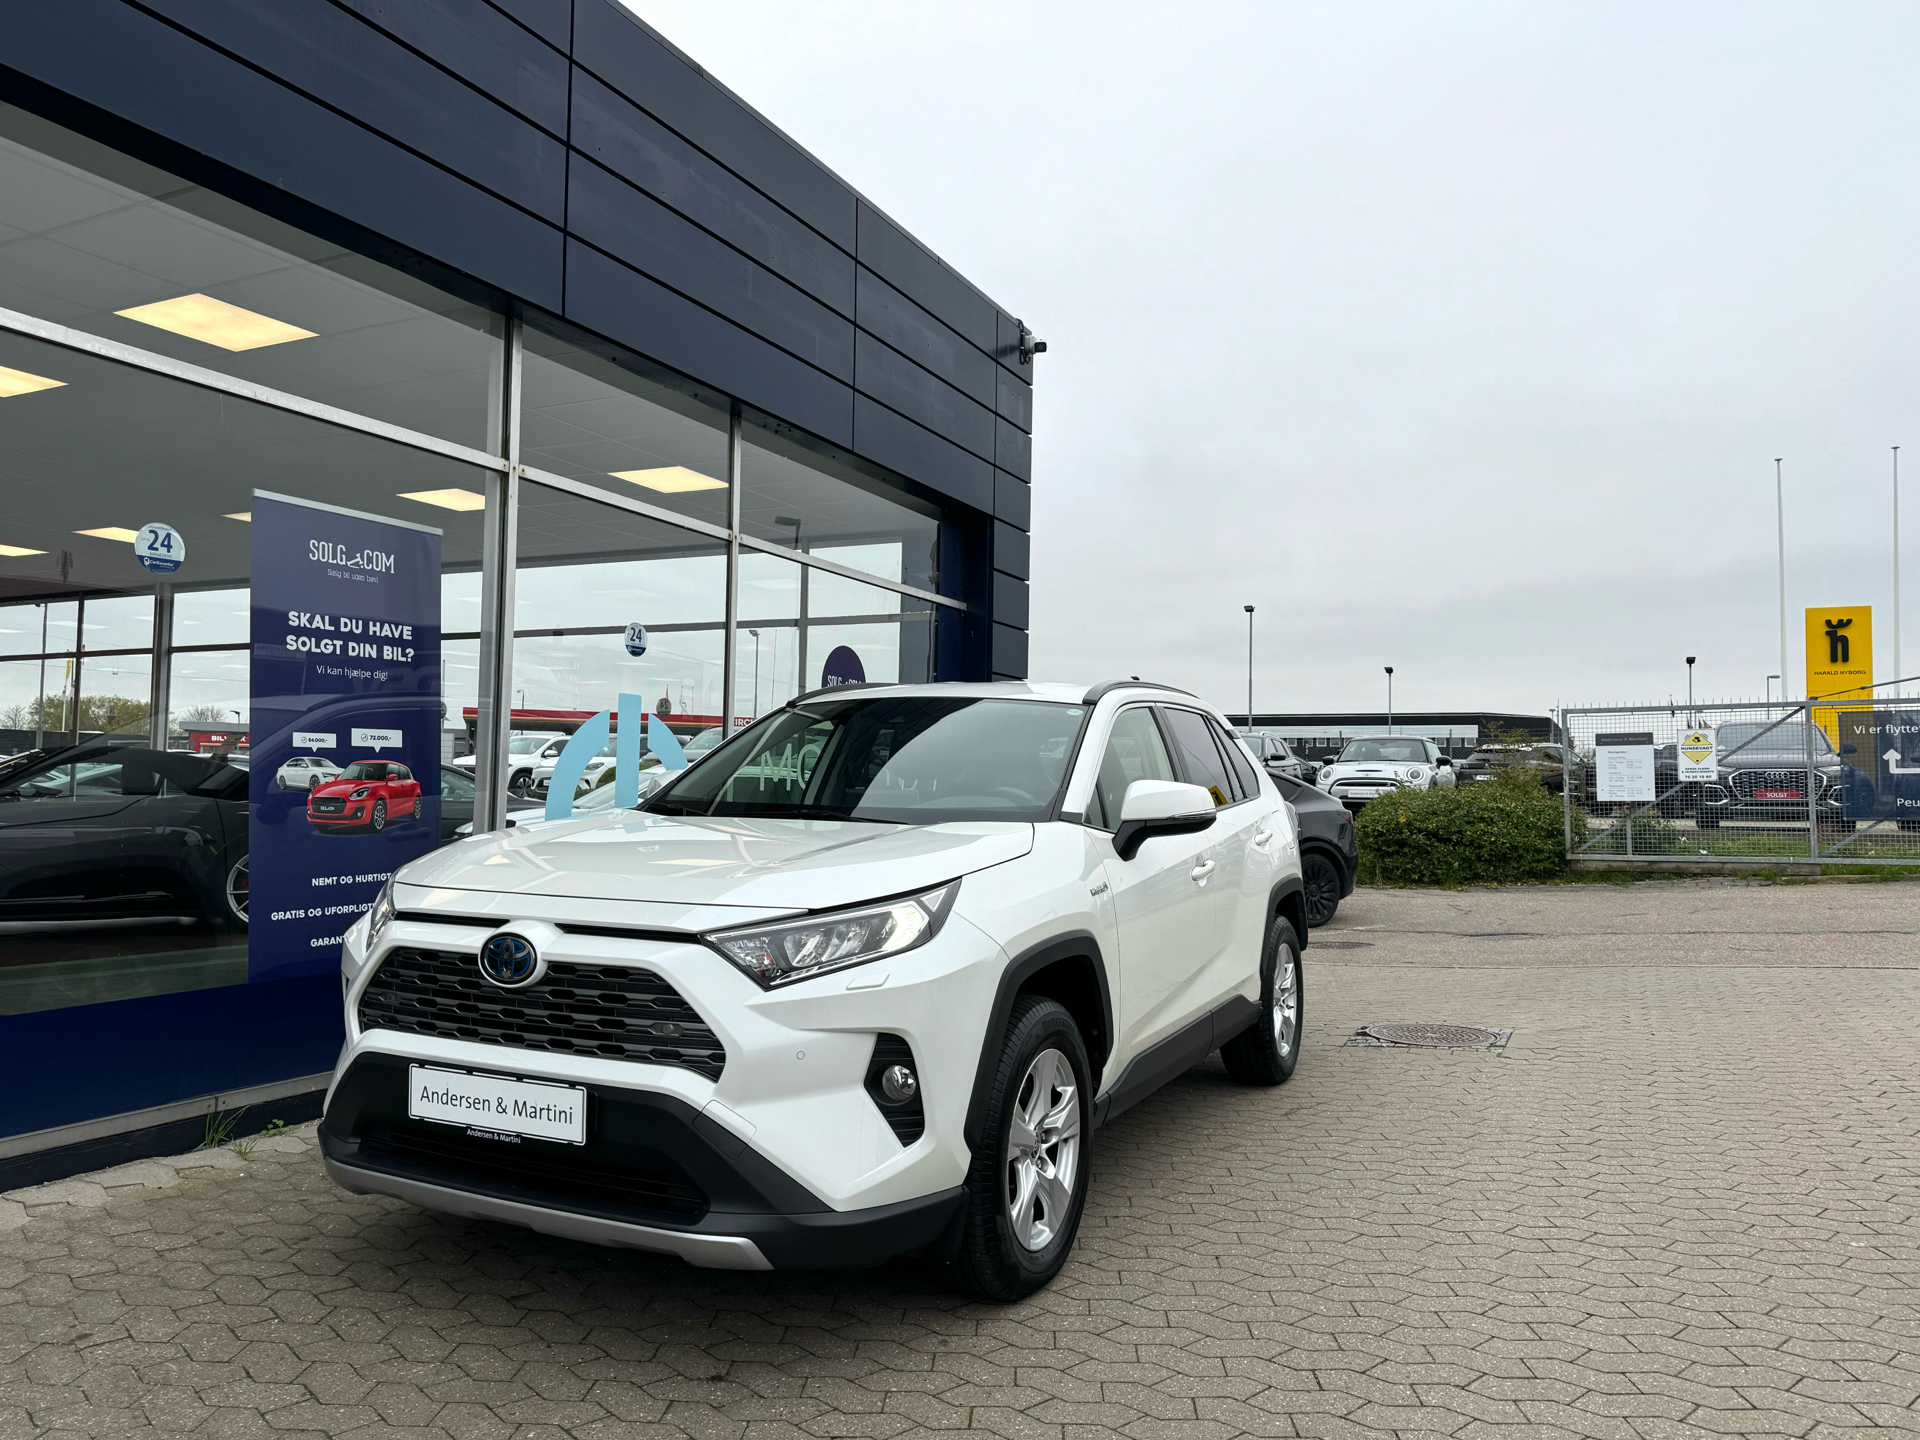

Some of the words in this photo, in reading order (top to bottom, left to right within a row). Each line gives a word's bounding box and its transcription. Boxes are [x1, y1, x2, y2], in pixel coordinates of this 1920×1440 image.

[148, 529, 172, 553] 24
[328, 569, 341, 579] Sælg
[352, 573, 365, 582] uden
[288, 610, 334, 631] SKAL
[340, 617, 362, 634] DU
[369, 621, 412, 640] HAVE
[630, 627, 642, 642] 24
[286, 634, 343, 655] SOLGT
[348, 641, 377, 659] DIN
[383, 645, 415, 662] BIL?
[316, 665, 325, 674] Vi
[327, 666, 342, 676] kan
[344, 667, 371, 680] hjælpe
[374, 670, 388, 682] dig!
[1854, 725, 1865, 734] Vi
[1886, 724, 1920, 736] flytte
[312, 877, 338, 886] NEMT
[340, 876, 353, 884] OG
[356, 872, 392, 883] HURTIGT
[271, 909, 305, 921] GRATIS
[308, 908, 322, 917] OG
[325, 902, 374, 915] UFORPLIGT
[420, 1086, 490, 1112] Andersen
[495, 1096, 508, 1115] &
[513, 1099, 572, 1124] Martini
[467, 1128, 493, 1140] Andersen
[500, 1134, 521, 1144] Martini
